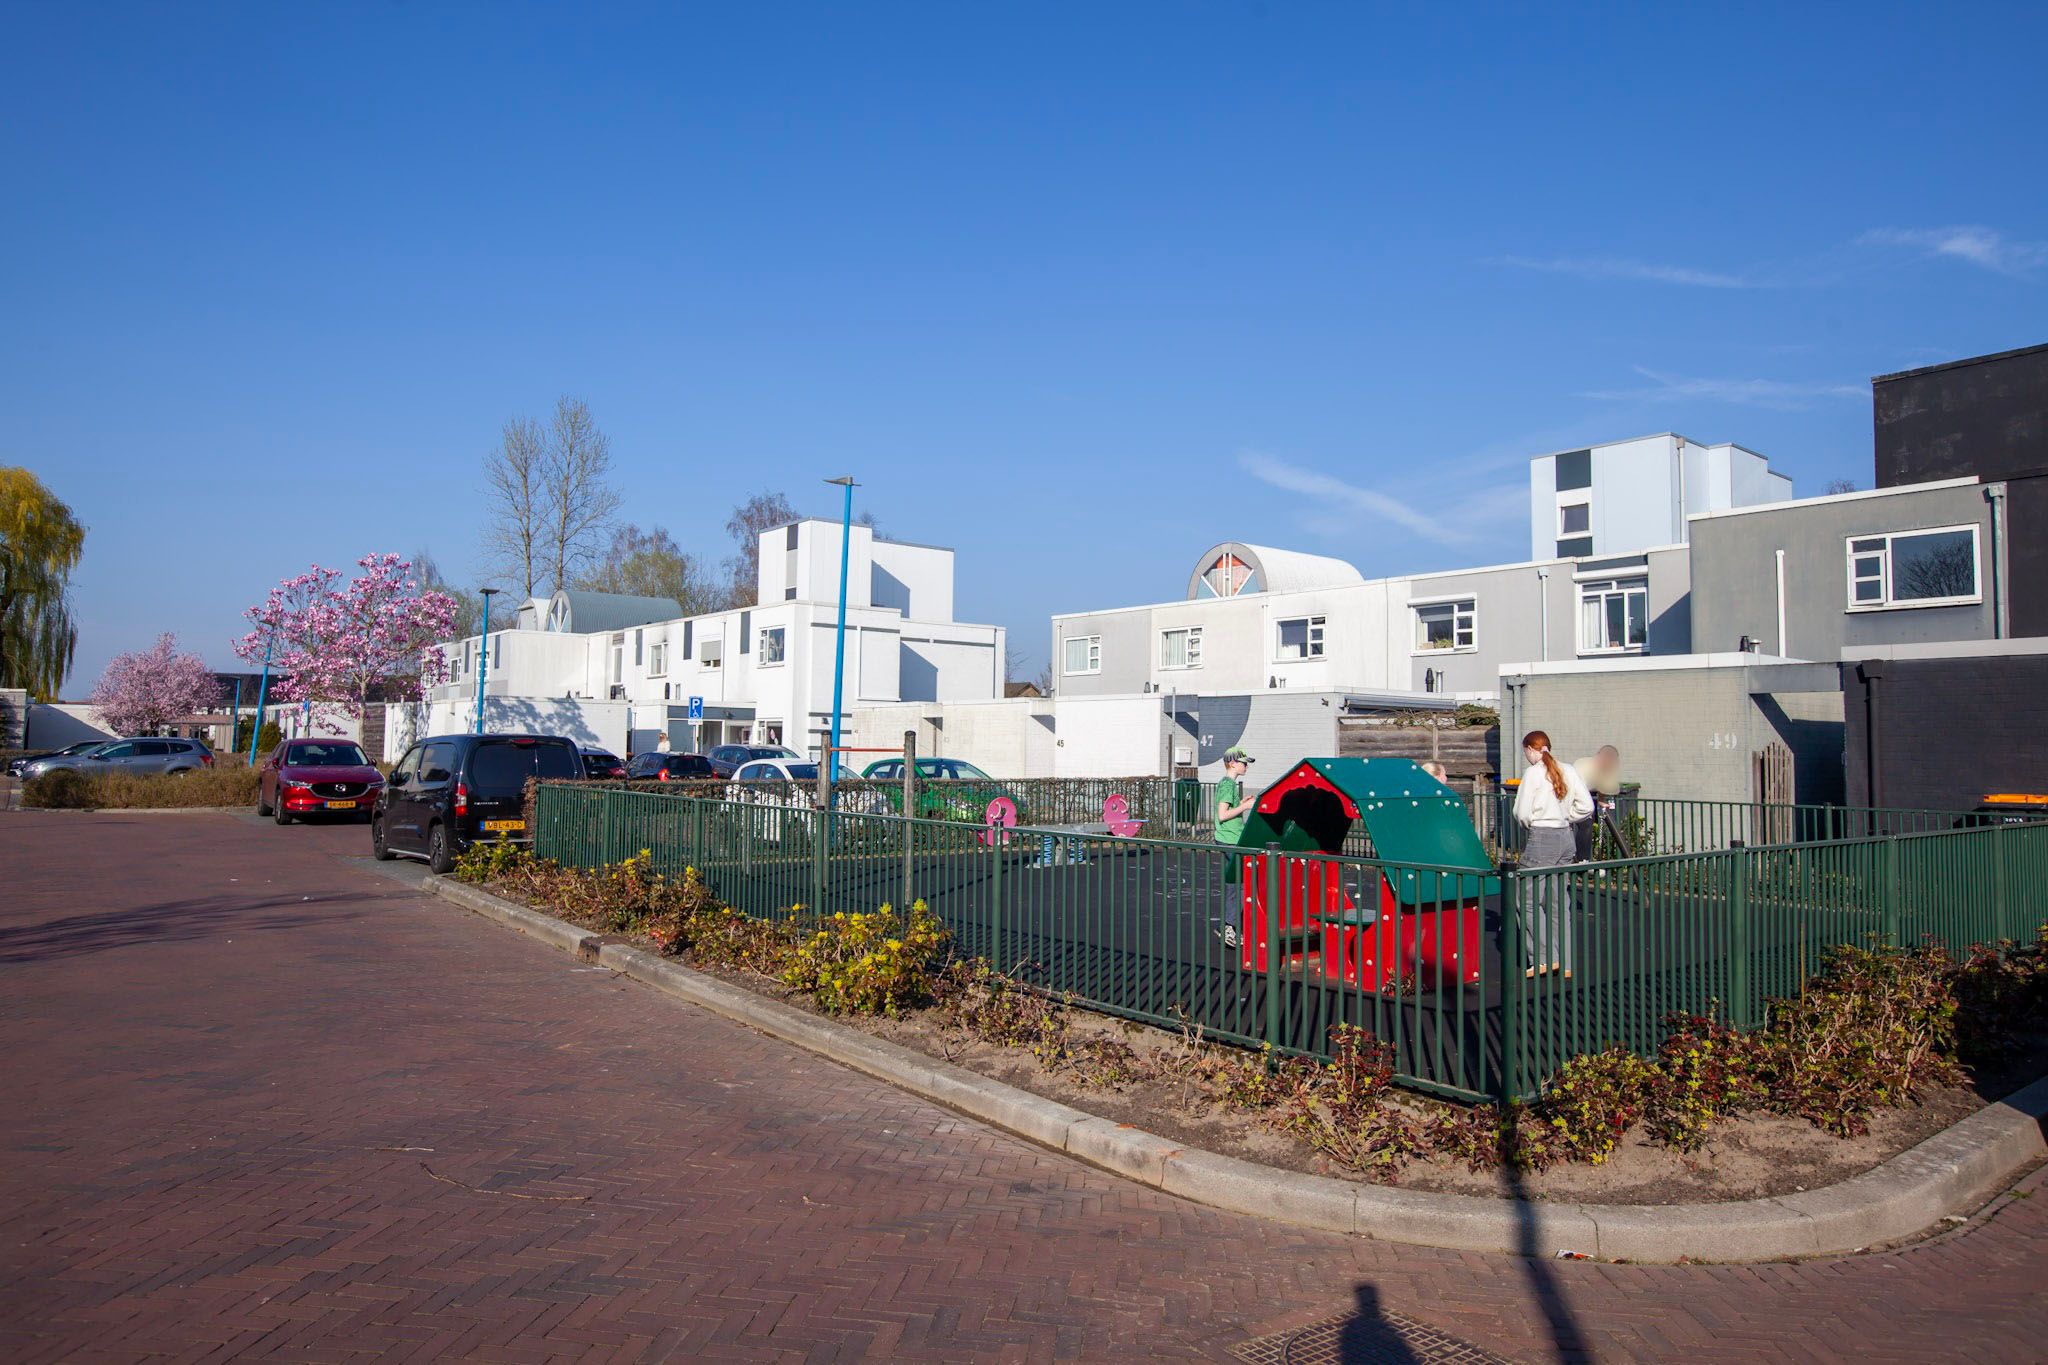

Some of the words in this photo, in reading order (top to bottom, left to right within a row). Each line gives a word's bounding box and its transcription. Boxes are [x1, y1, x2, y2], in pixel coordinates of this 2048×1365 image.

[692, 698, 701, 710] P
[1056, 739, 1065, 748] 45
[1200, 735, 1214, 747] 47
[1708, 732, 1738, 750] 49
